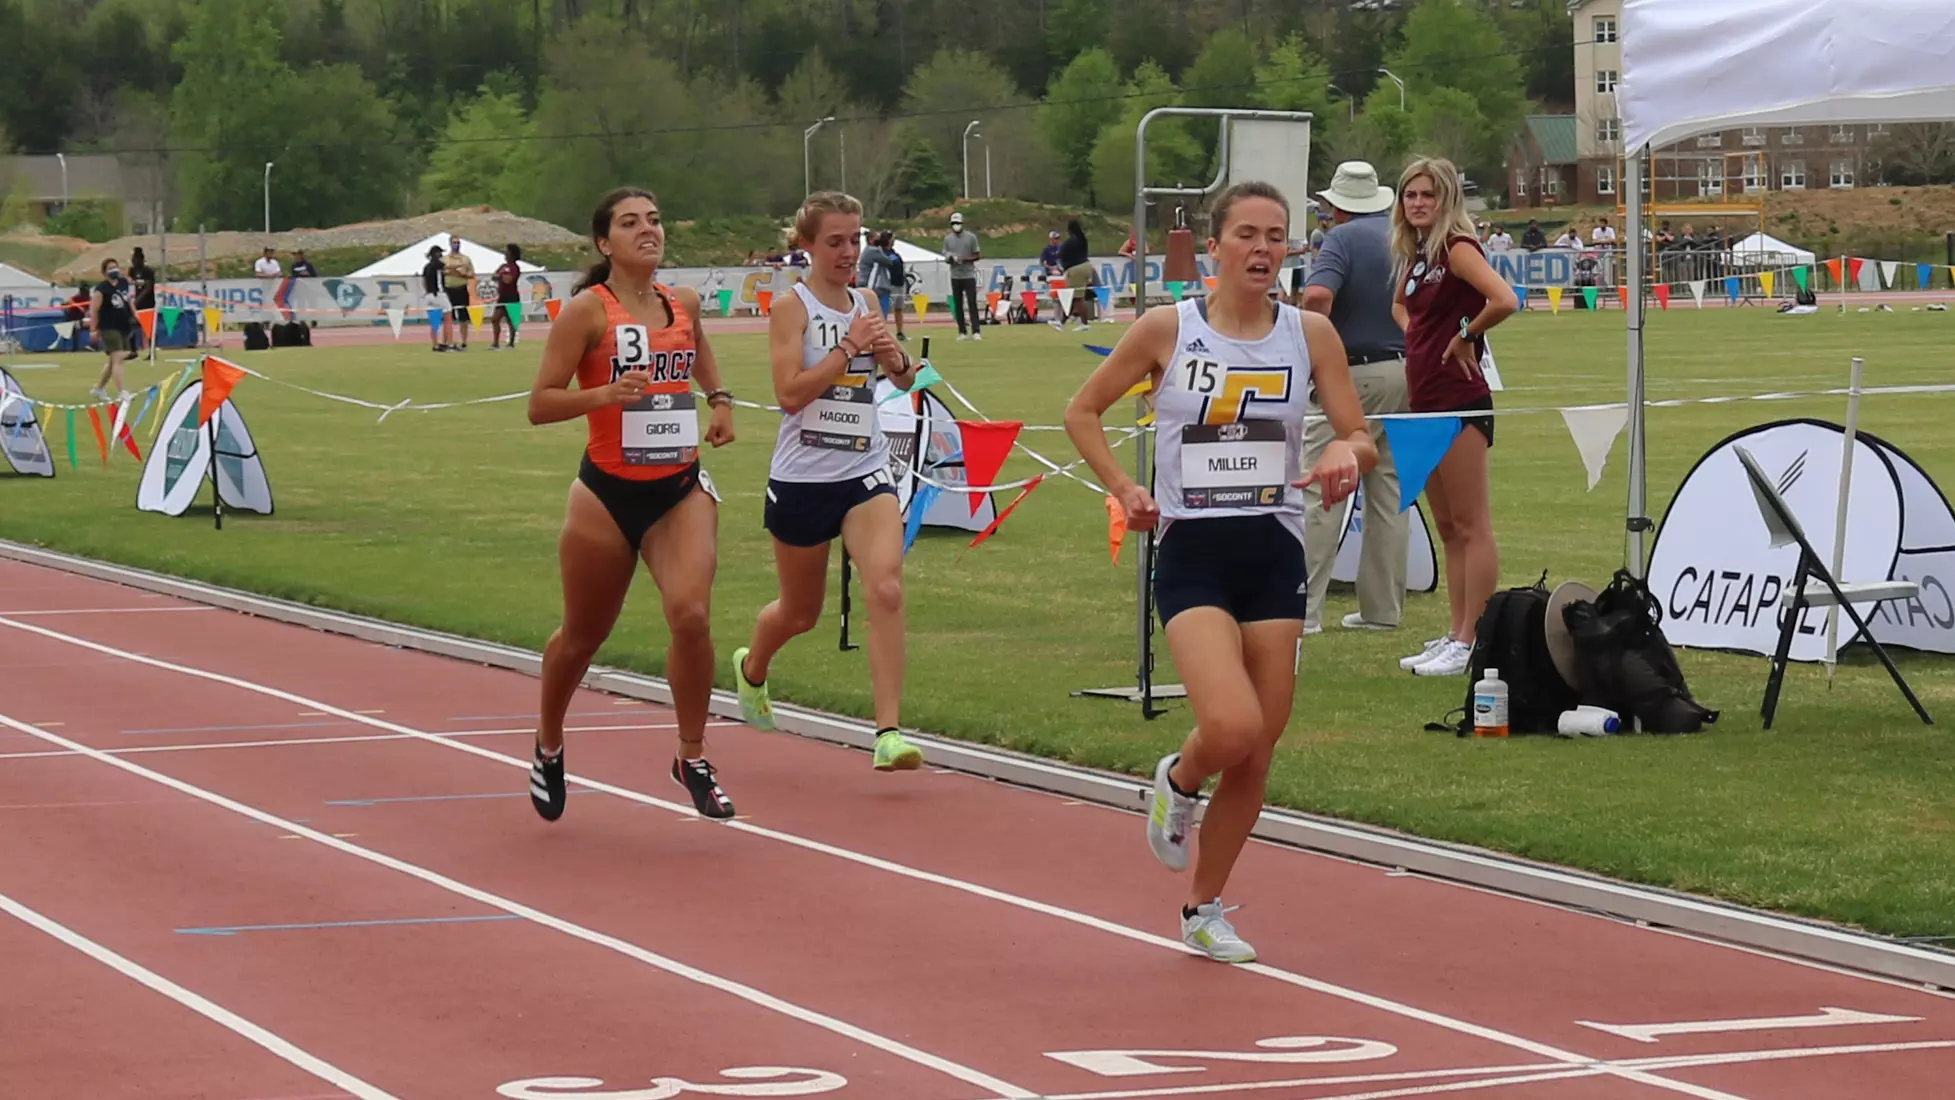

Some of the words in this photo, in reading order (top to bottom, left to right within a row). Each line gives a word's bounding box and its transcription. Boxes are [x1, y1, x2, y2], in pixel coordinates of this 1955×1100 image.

[624, 327, 642, 363] 3
[1186, 359, 1218, 393] 15
[646, 423, 681, 435] GIORGI
[819, 410, 860, 425] HAGOOD
[1208, 457, 1258, 472] MILLER
[1575, 1006, 1926, 1043] 1
[1043, 1036, 1397, 1076] 2
[496, 1066, 848, 1100] 3
